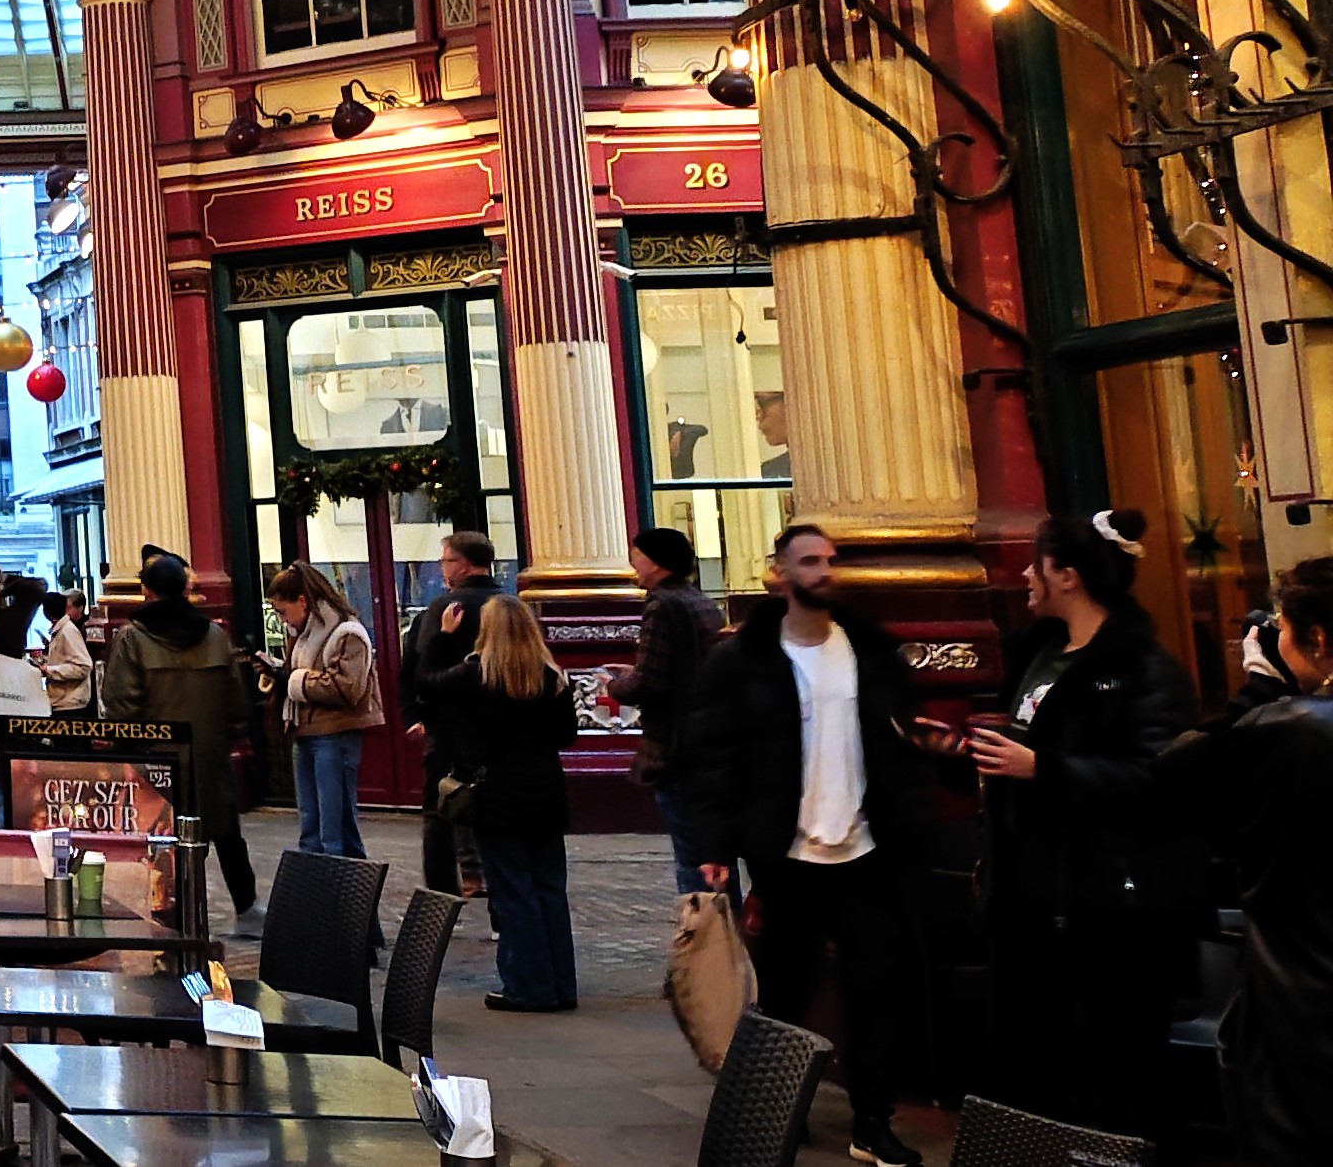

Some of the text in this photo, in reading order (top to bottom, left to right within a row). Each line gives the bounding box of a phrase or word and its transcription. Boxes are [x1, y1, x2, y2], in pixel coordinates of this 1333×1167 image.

[684, 163, 730, 191] 26
[295, 187, 395, 222] REISS
[309, 364, 425, 395] REISS
[45, 779, 140, 805] GET SET
[48, 804, 140, 830] FOR OUR
